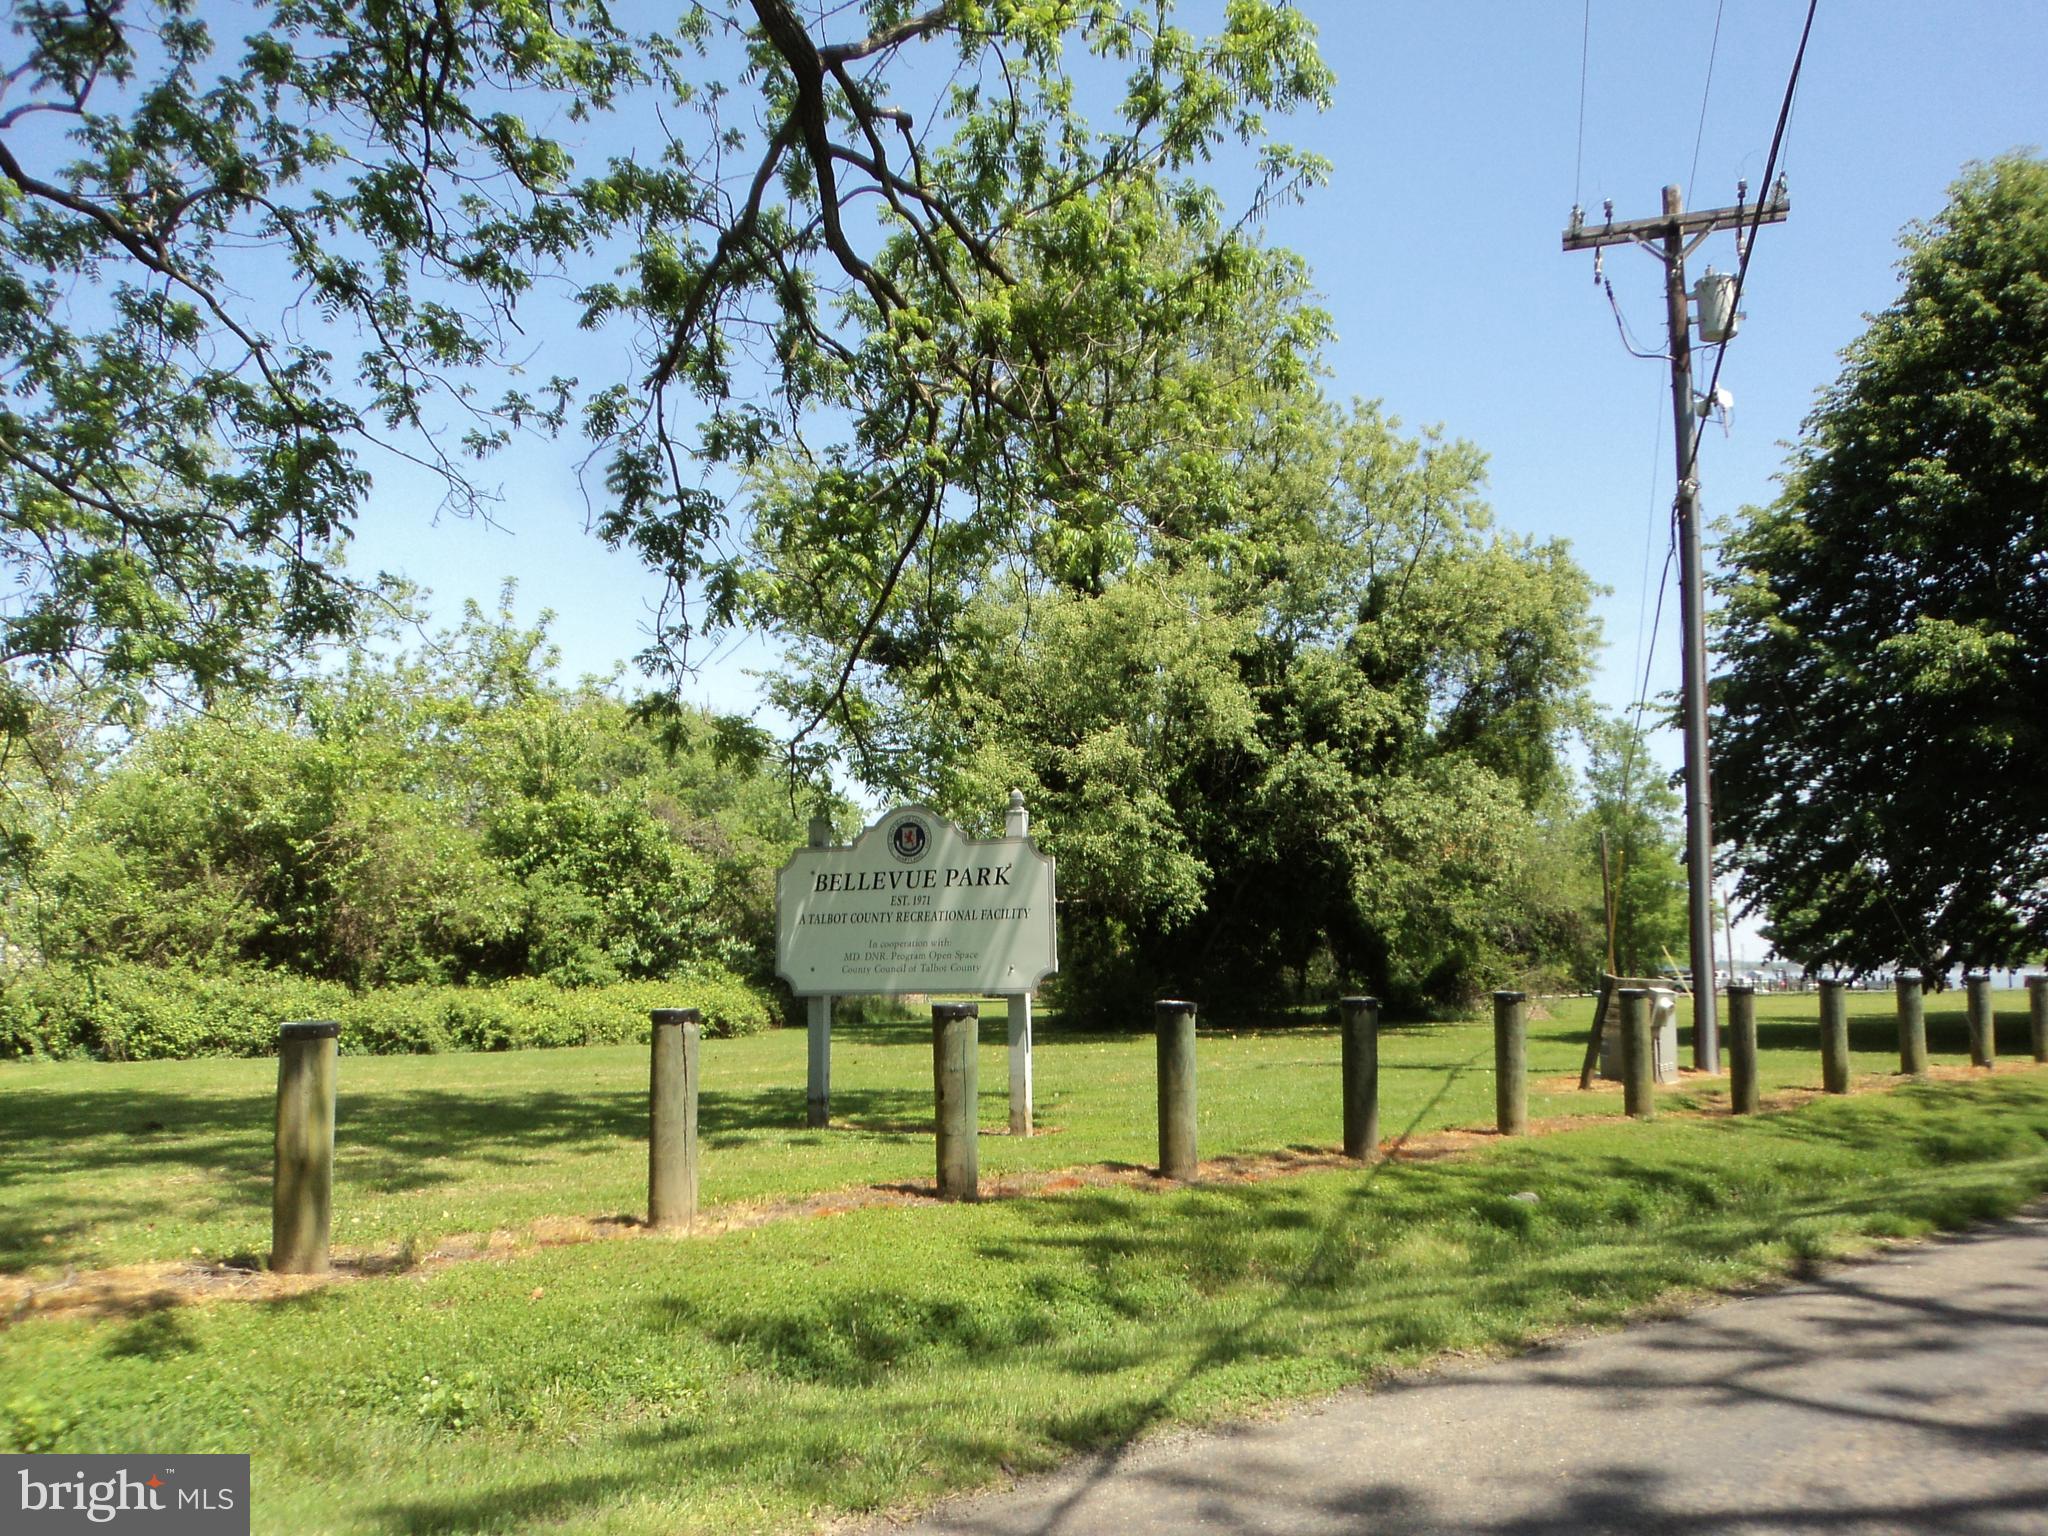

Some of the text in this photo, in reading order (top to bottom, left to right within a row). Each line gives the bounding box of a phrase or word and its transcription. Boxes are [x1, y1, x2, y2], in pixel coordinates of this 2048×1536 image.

[814, 866, 1010, 893] BELLEVUE PARK
[890, 895, 931, 906] EST. 1971
[799, 907, 1031, 925] A TALBOT COUNTY RECREATIONAL FACILITY
[868, 939, 878, 949] In
[880, 940, 928, 951] cooperation
[891, 951, 926, 962] Program
[929, 951, 952, 961] Open
[954, 950, 979, 961] Space
[841, 963, 981, 975] County Council of Talbot County
